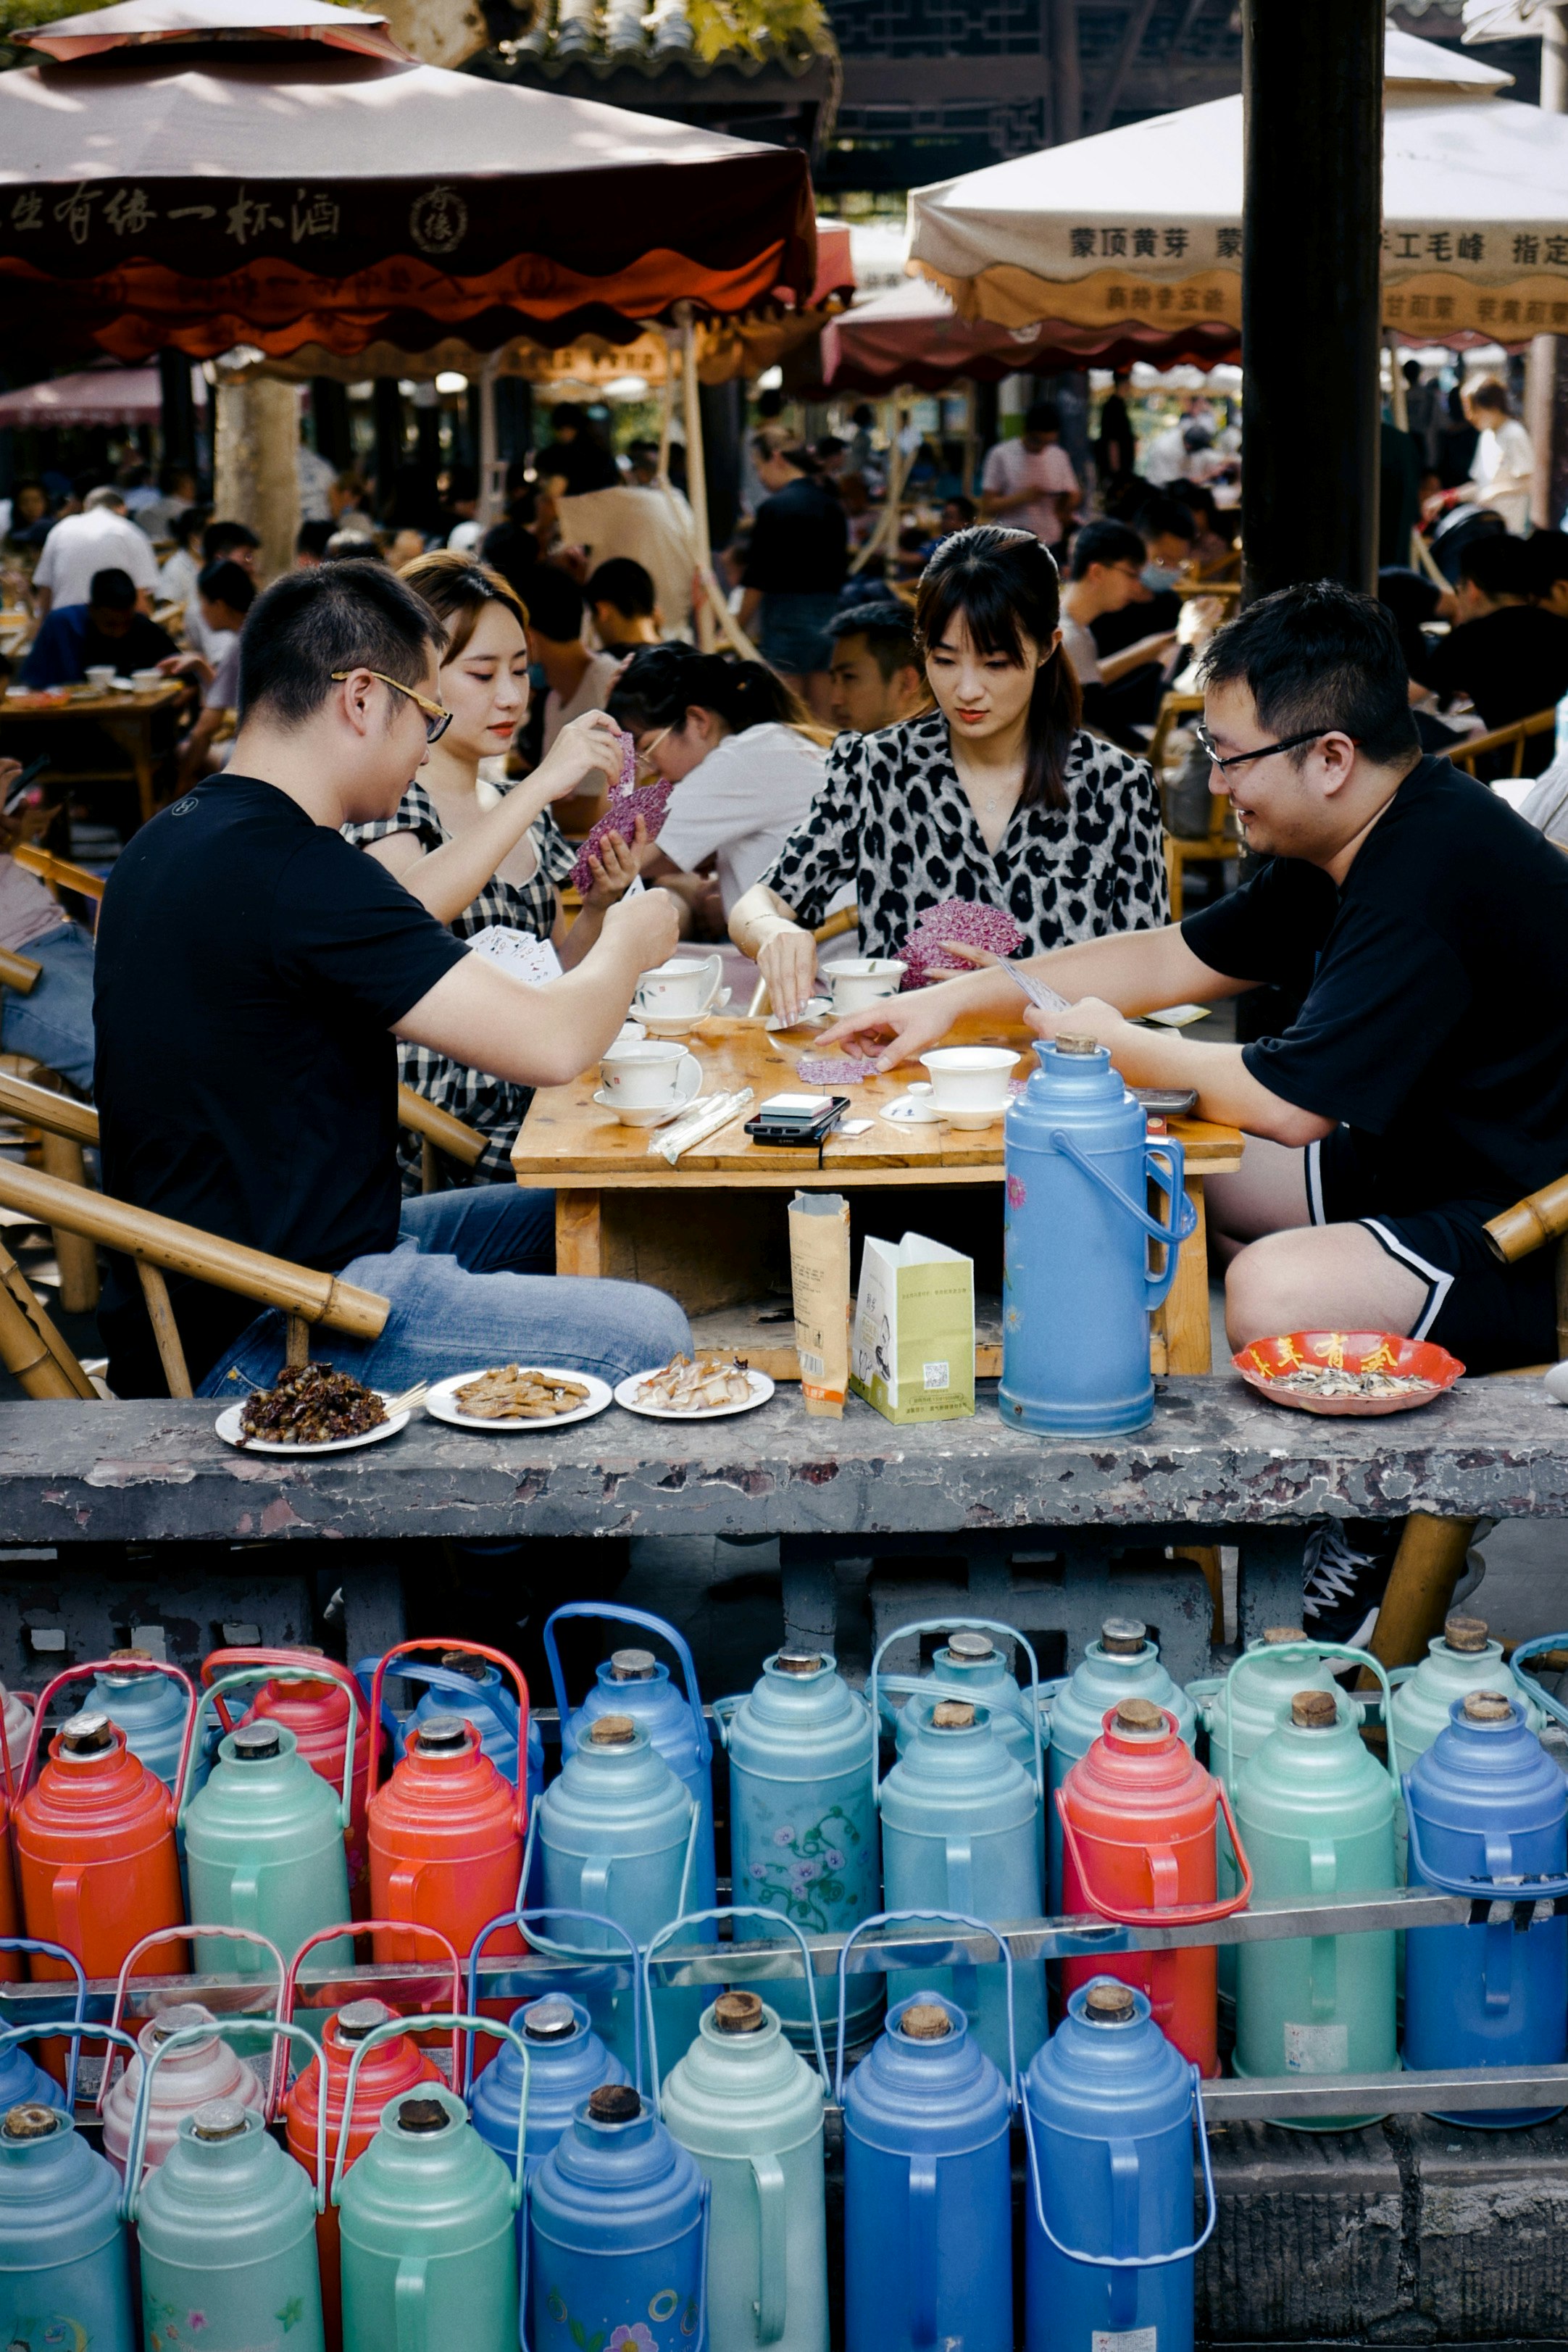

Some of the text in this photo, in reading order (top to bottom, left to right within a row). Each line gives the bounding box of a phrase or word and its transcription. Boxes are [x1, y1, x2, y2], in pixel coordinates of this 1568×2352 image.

[1070, 228, 1189, 257] 蒙顶黄芽
[1513, 234, 1568, 265] 指定
